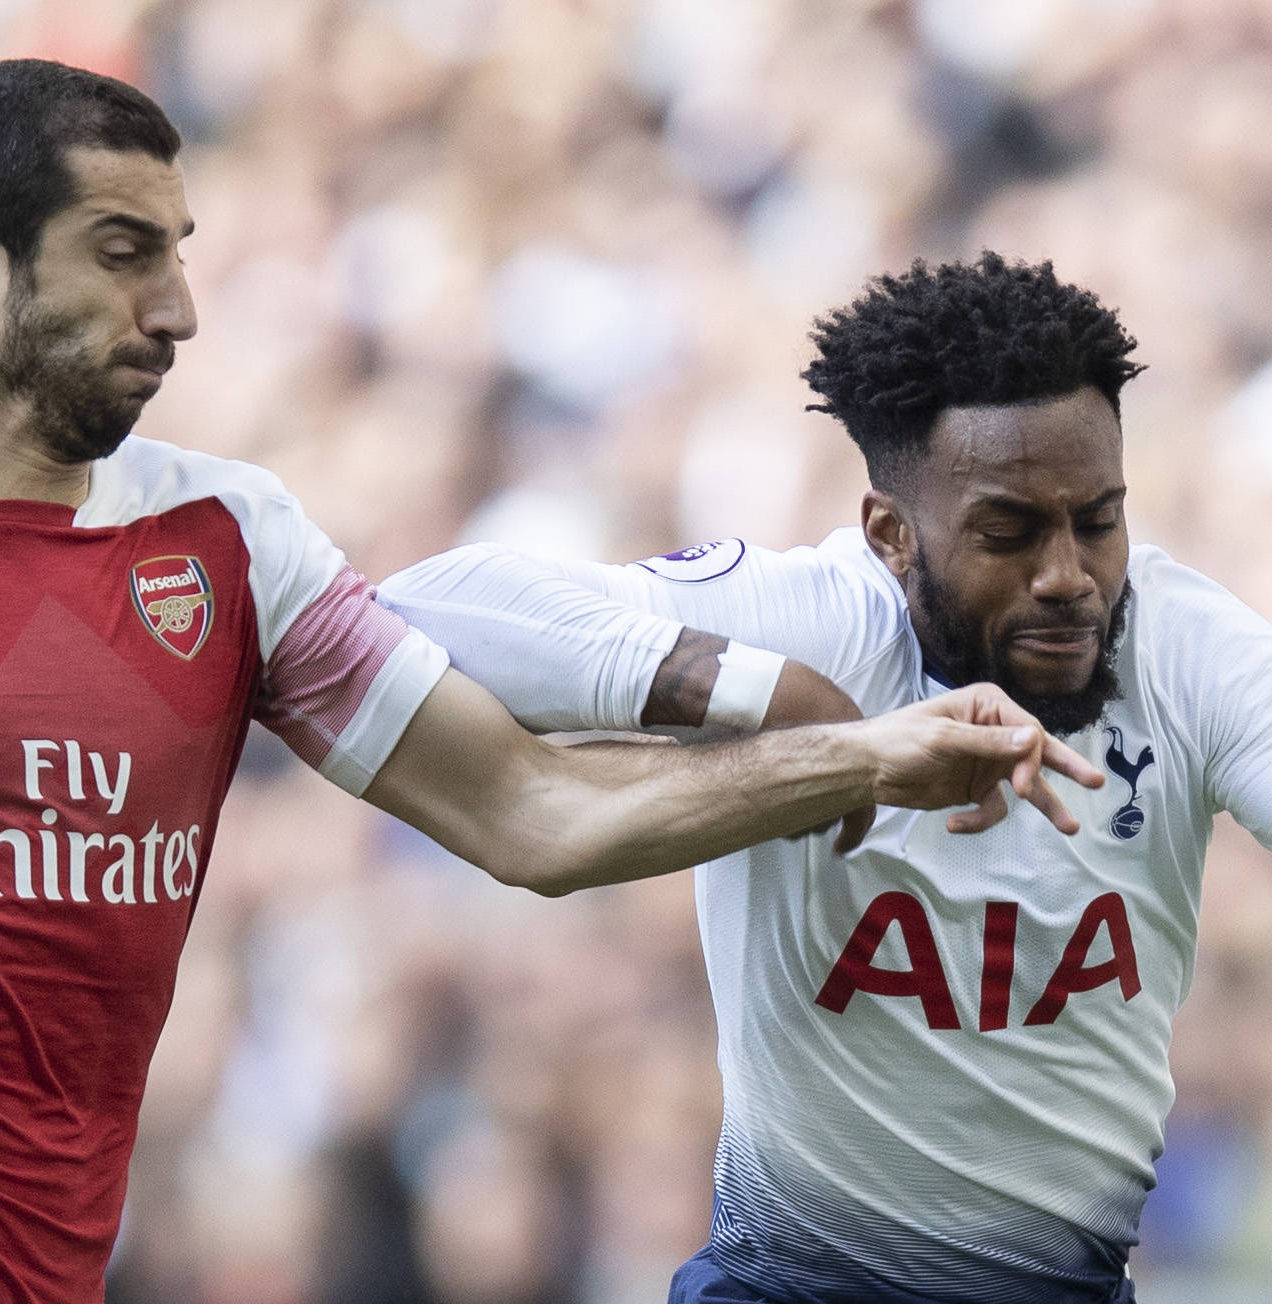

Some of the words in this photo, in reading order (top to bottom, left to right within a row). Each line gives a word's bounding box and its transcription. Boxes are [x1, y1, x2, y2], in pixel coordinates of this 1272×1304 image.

[138, 568, 197, 594] Arsenal
[21, 739, 131, 815] Fly
[814, 890, 1142, 1032] AIA
